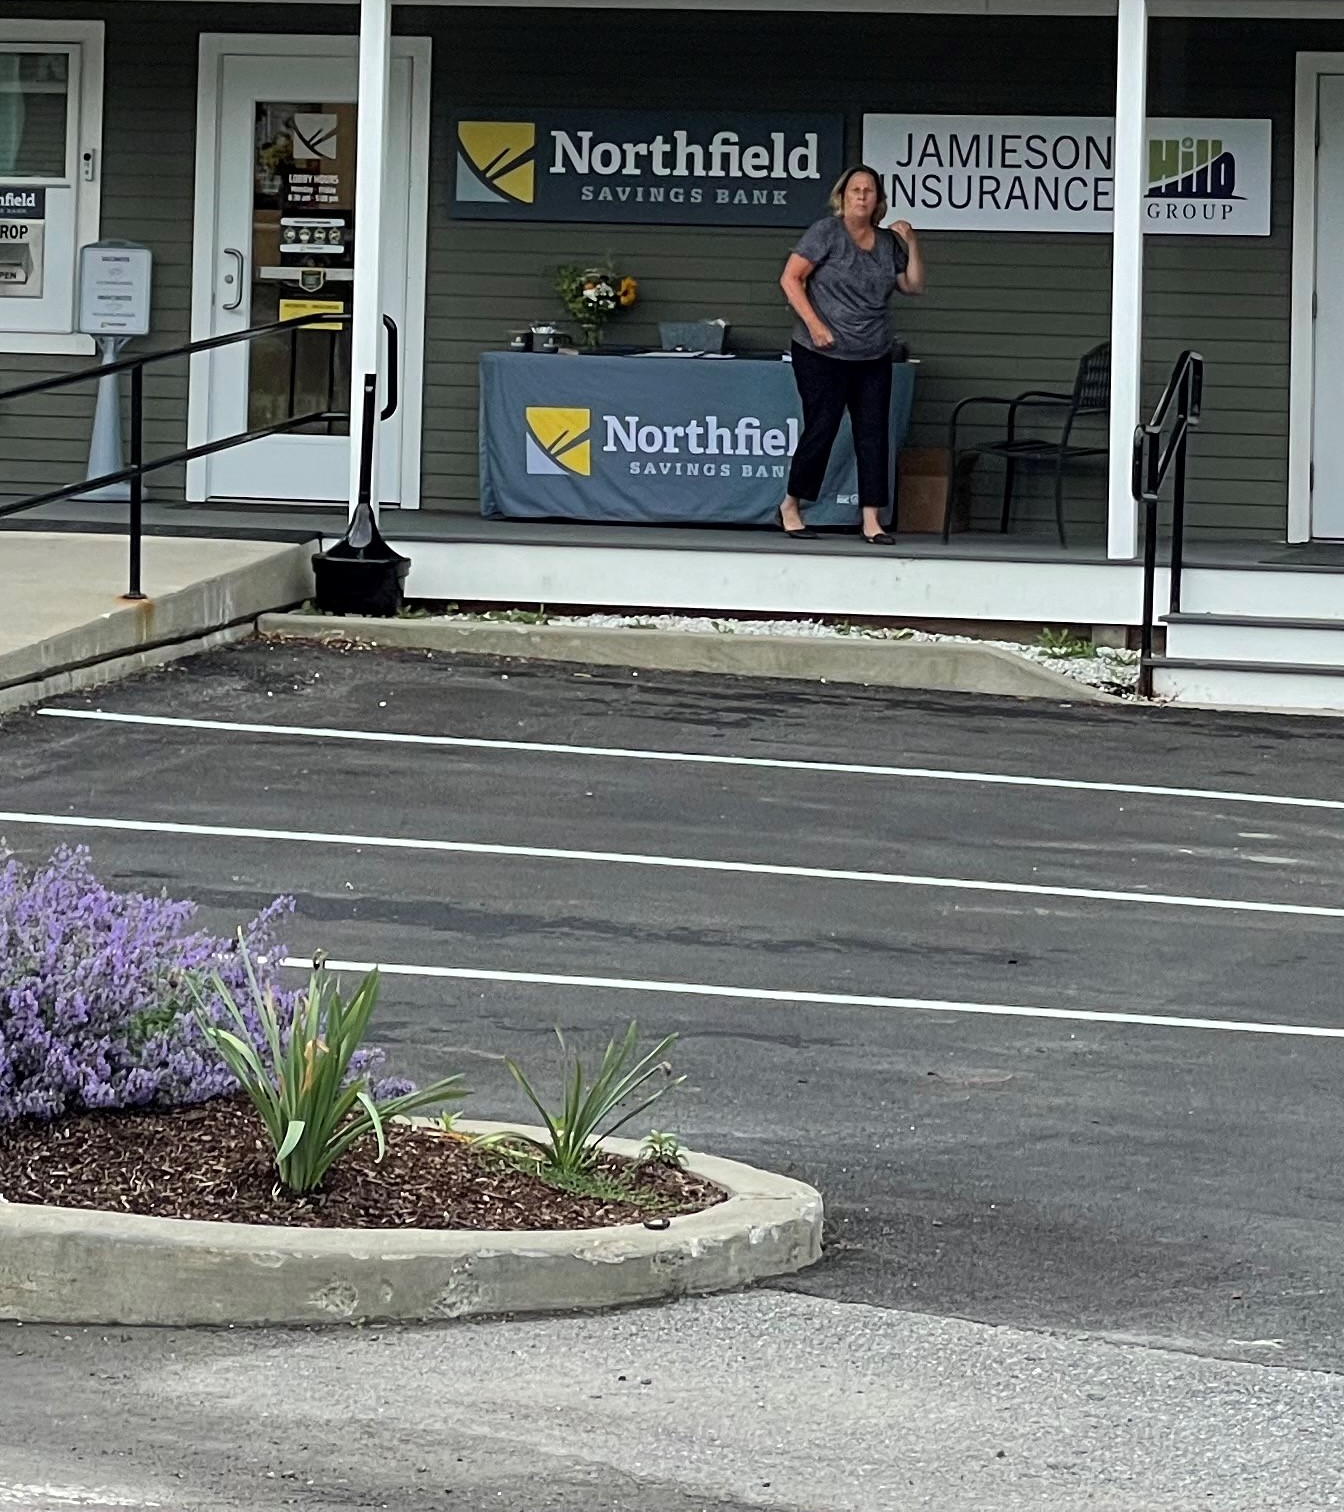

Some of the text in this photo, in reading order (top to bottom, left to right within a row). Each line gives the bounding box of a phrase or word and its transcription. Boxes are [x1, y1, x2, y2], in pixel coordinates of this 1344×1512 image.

[549, 130, 821, 180] Northfield
[895, 133, 1113, 170] JAMIESON
[581, 185, 788, 206] SAVINGS BANK
[1147, 203, 1233, 220] GROUP
[602, 415, 800, 457] Northfiel
[629, 461, 788, 478] SAVINGS BAN
